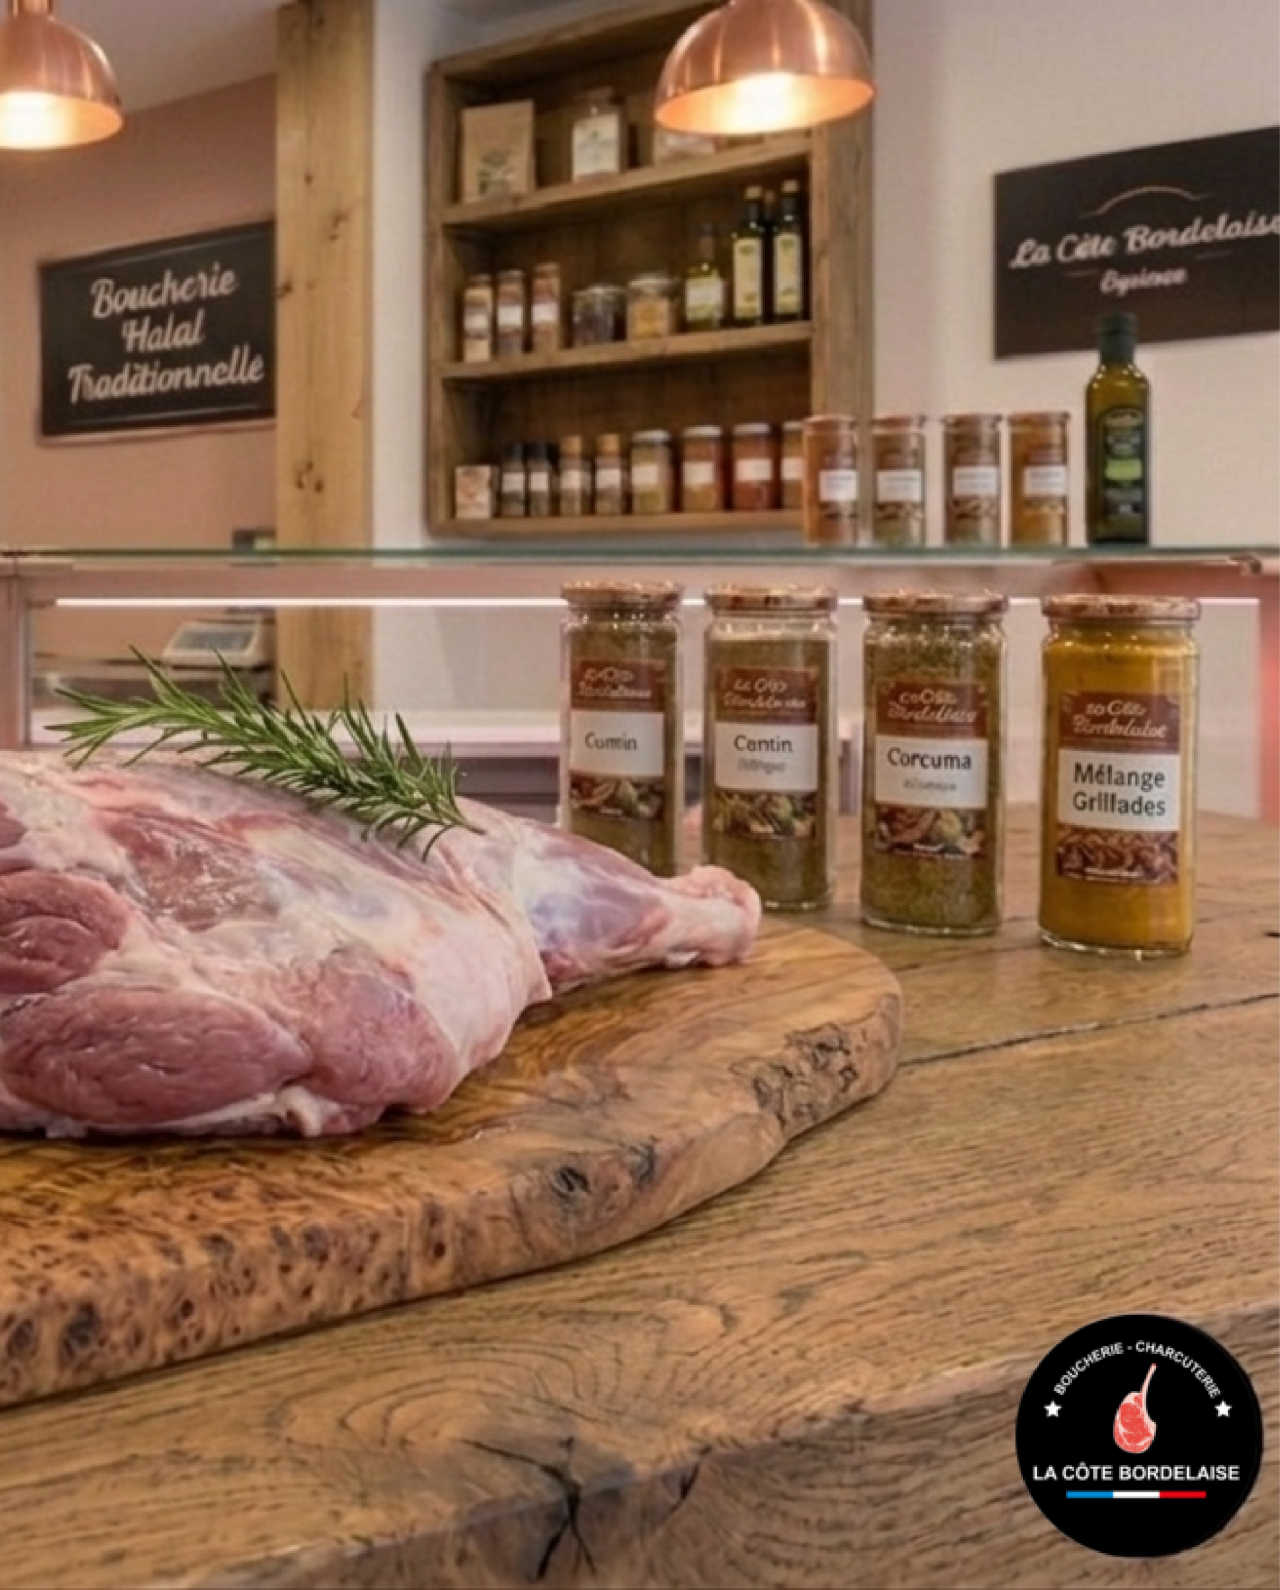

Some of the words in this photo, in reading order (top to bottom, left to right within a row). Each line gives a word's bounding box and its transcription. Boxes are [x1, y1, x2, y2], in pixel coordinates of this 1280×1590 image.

[1008, 238, 1051, 269] La
[90, 260, 237, 319] Boucherie
[122, 307, 205, 353] Halal
[67, 342, 265, 404] Traditionnelle
[584, 730, 638, 751] Cumin
[1073, 762, 1166, 792] Mélange
[1072, 790, 1166, 817] Grillades
